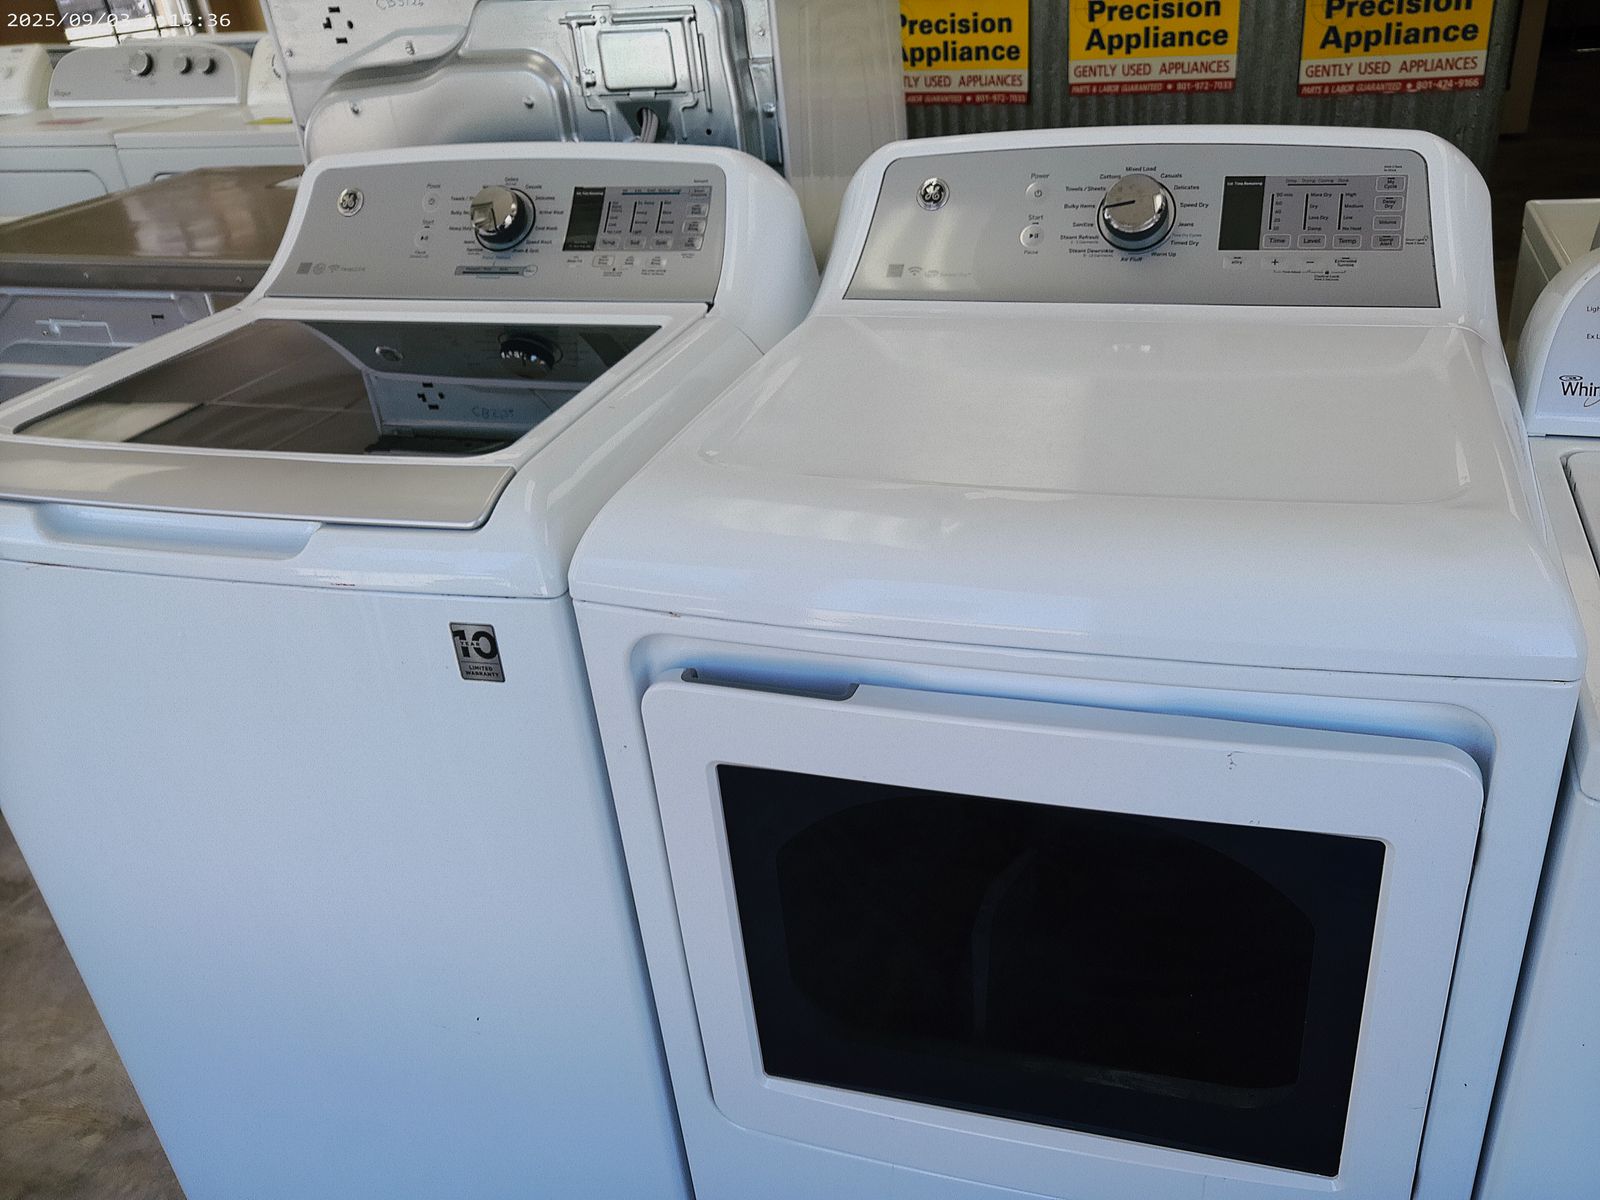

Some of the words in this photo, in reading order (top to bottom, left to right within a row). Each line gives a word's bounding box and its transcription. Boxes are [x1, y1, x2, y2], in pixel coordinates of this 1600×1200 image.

[1088, 0, 1221, 22] Precision
[1324, 0, 1473, 19] Precision
[1085, 27, 1229, 55] Appliance
[1319, 22, 1480, 53] Appliance
[1073, 63, 1118, 78] GENTLY
[1122, 63, 1151, 76] USED
[1159, 60, 1230, 75] APPLIANCES
[1305, 63, 1353, 78] GENTLY
[1358, 61, 1391, 75] USED
[1399, 56, 1478, 73] APPLIANCES
[923, 75, 951, 88] USED
[958, 74, 1023, 87] APPLIANCES
[452, 629, 498, 660] 10
